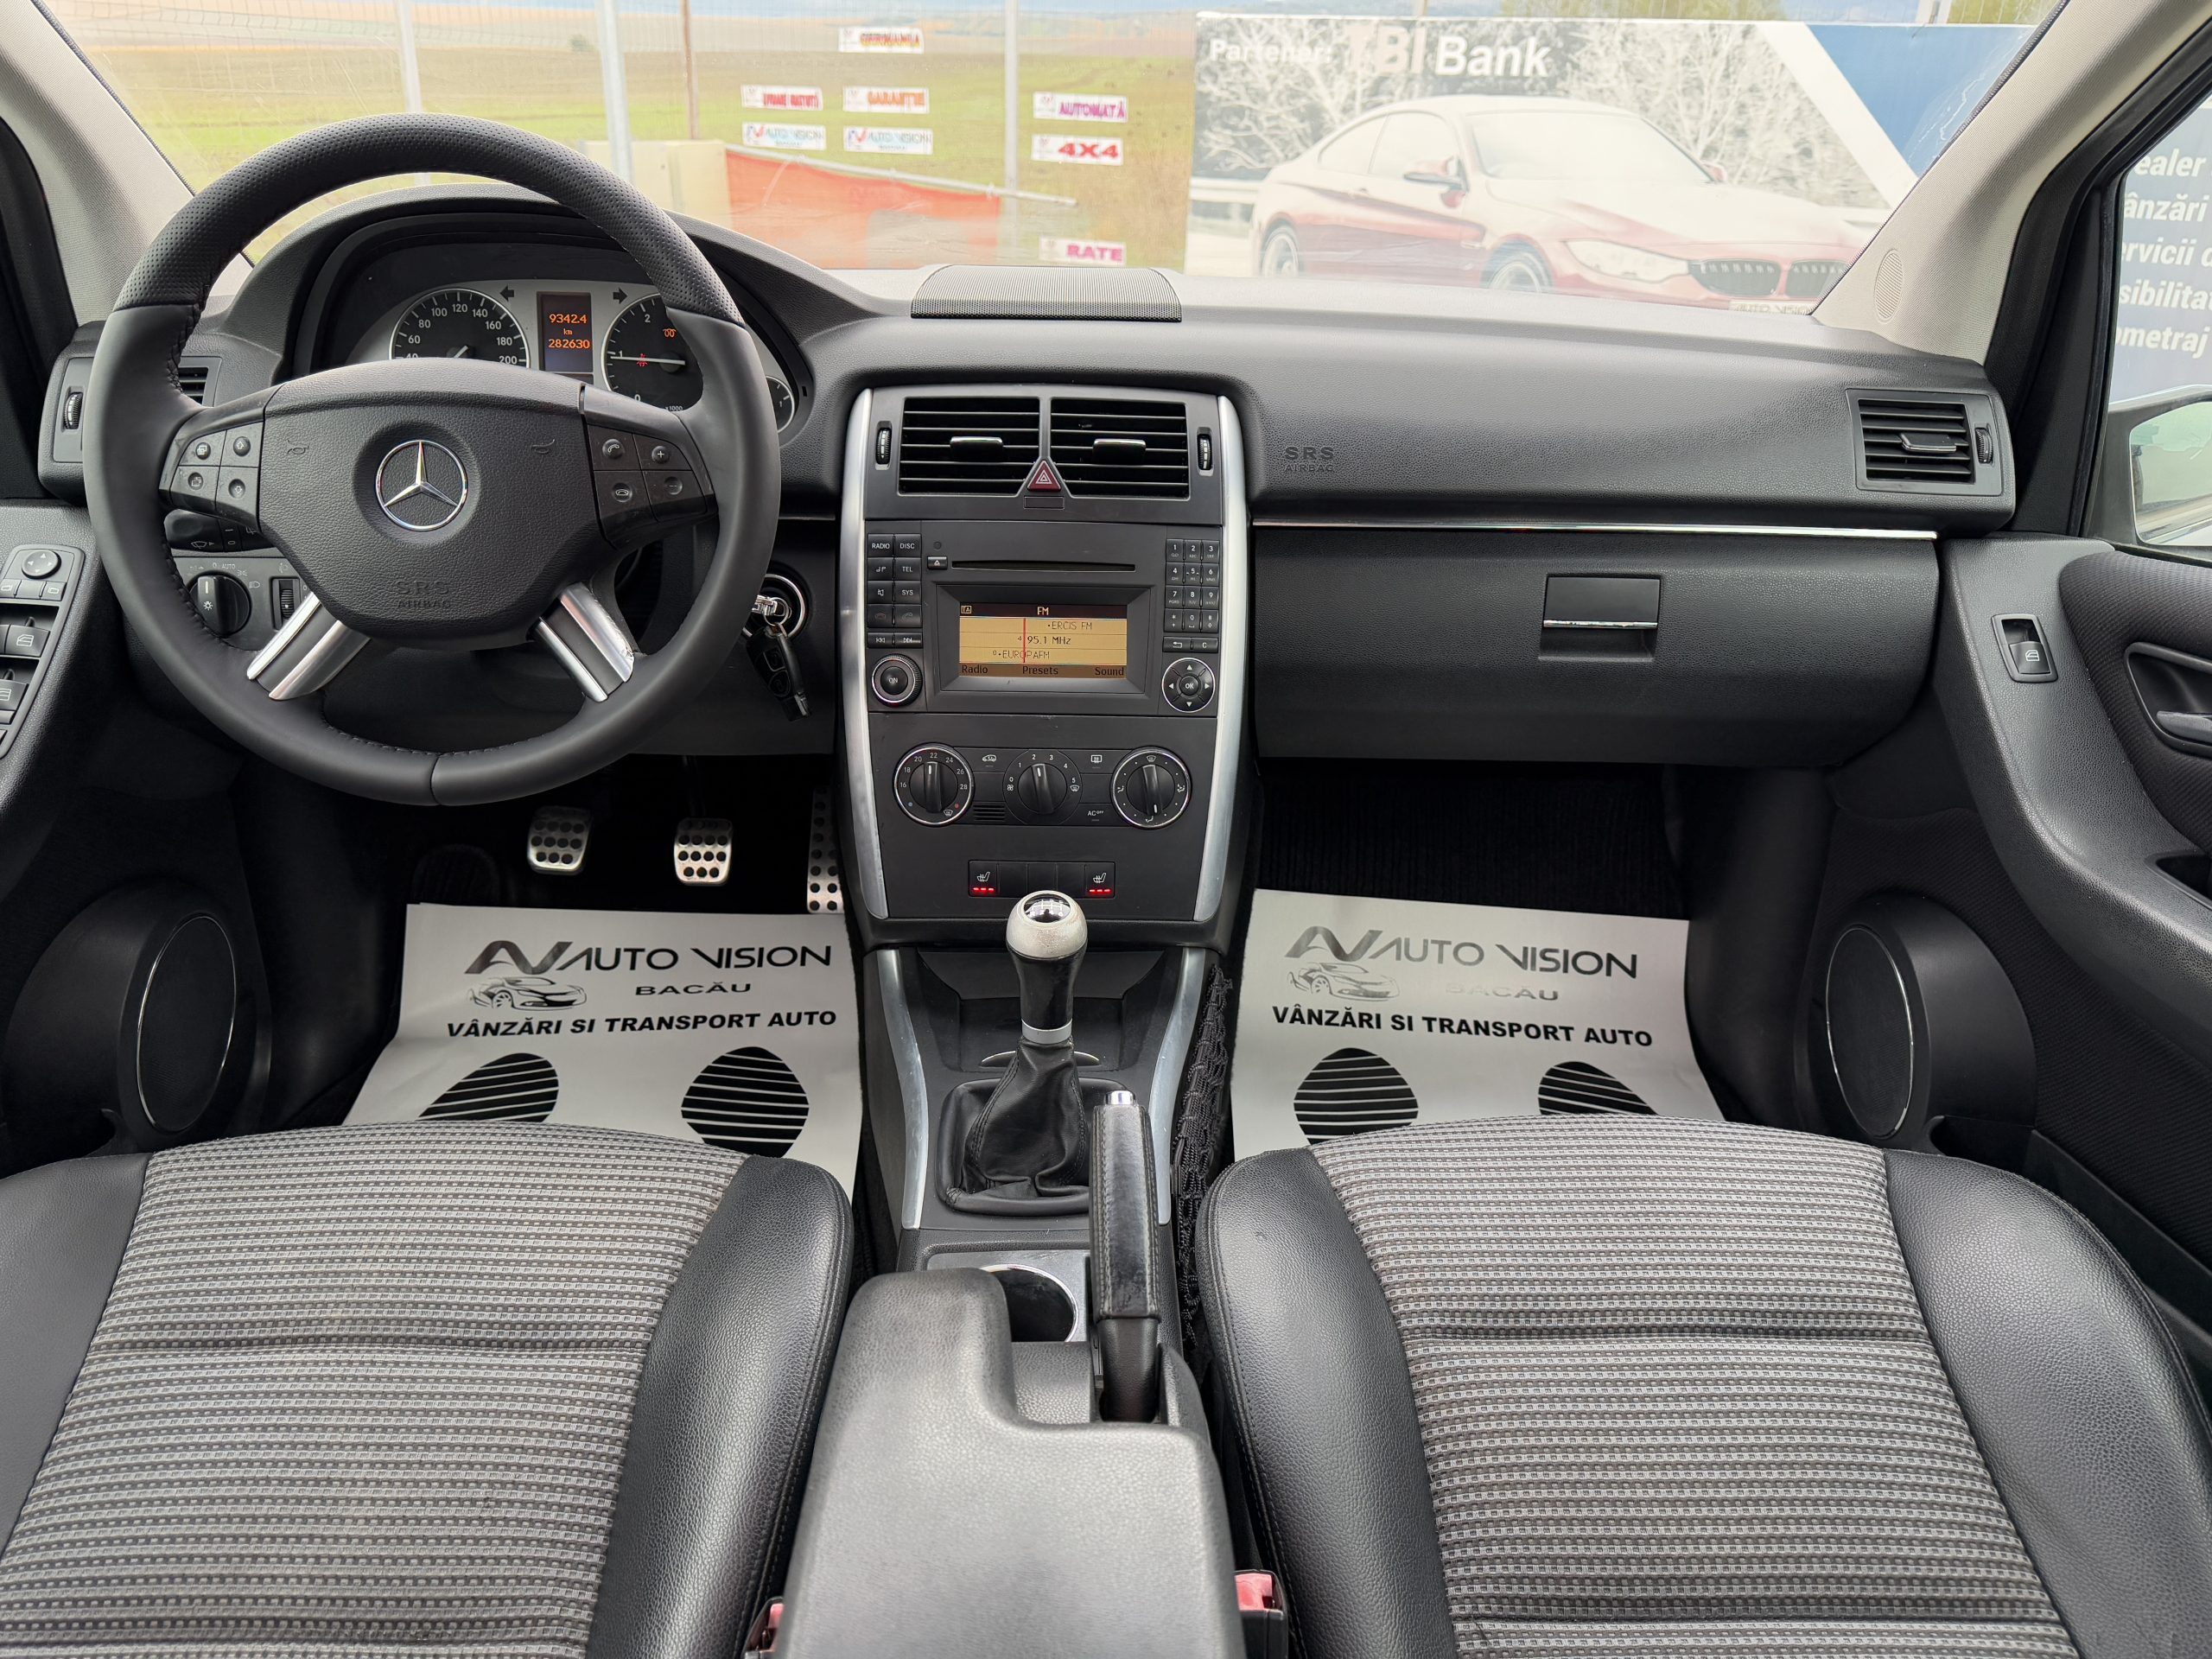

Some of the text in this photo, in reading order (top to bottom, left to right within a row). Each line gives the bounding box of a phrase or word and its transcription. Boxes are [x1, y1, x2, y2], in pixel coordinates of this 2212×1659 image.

[1344, 24, 1427, 75] TBI
[1435, 35, 1551, 77] Bank
[1058, 143, 1118, 158] 4X4
[1066, 245, 1122, 262] RATE
[431, 308, 448, 317] 100
[452, 303, 467, 313] 120
[472, 308, 488, 318] 140
[418, 319, 431, 328] 80
[549, 314, 588, 324] 9342.4
[644, 314, 651, 323] 2
[485, 321, 502, 330] 160
[408, 334, 421, 344] 60
[496, 337, 512, 346] 180
[548, 339, 590, 349] 282630
[499, 355, 518, 365] 200
[1285, 446, 1334, 461] SRS
[1037, 607, 1049, 616] FM
[1052, 621, 1092, 630] ERCIS FM
[1027, 636, 1047, 645] 95.1
[1052, 636, 1071, 645] MHz
[962, 664, 1124, 676] Radio Presets Sound
[556, 946, 679, 971] AUTO
[690, 944, 831, 969] VISION
[1368, 937, 1485, 966] AUTO
[1496, 943, 1637, 979] VISION
[634, 981, 752, 996] BACĂU
[447, 1010, 837, 1037] VÂNZĂRI SI TRANSPORT AUTO
[1272, 1002, 1653, 1047] VÂNZĂRI SI TRANSPORT AUTO
